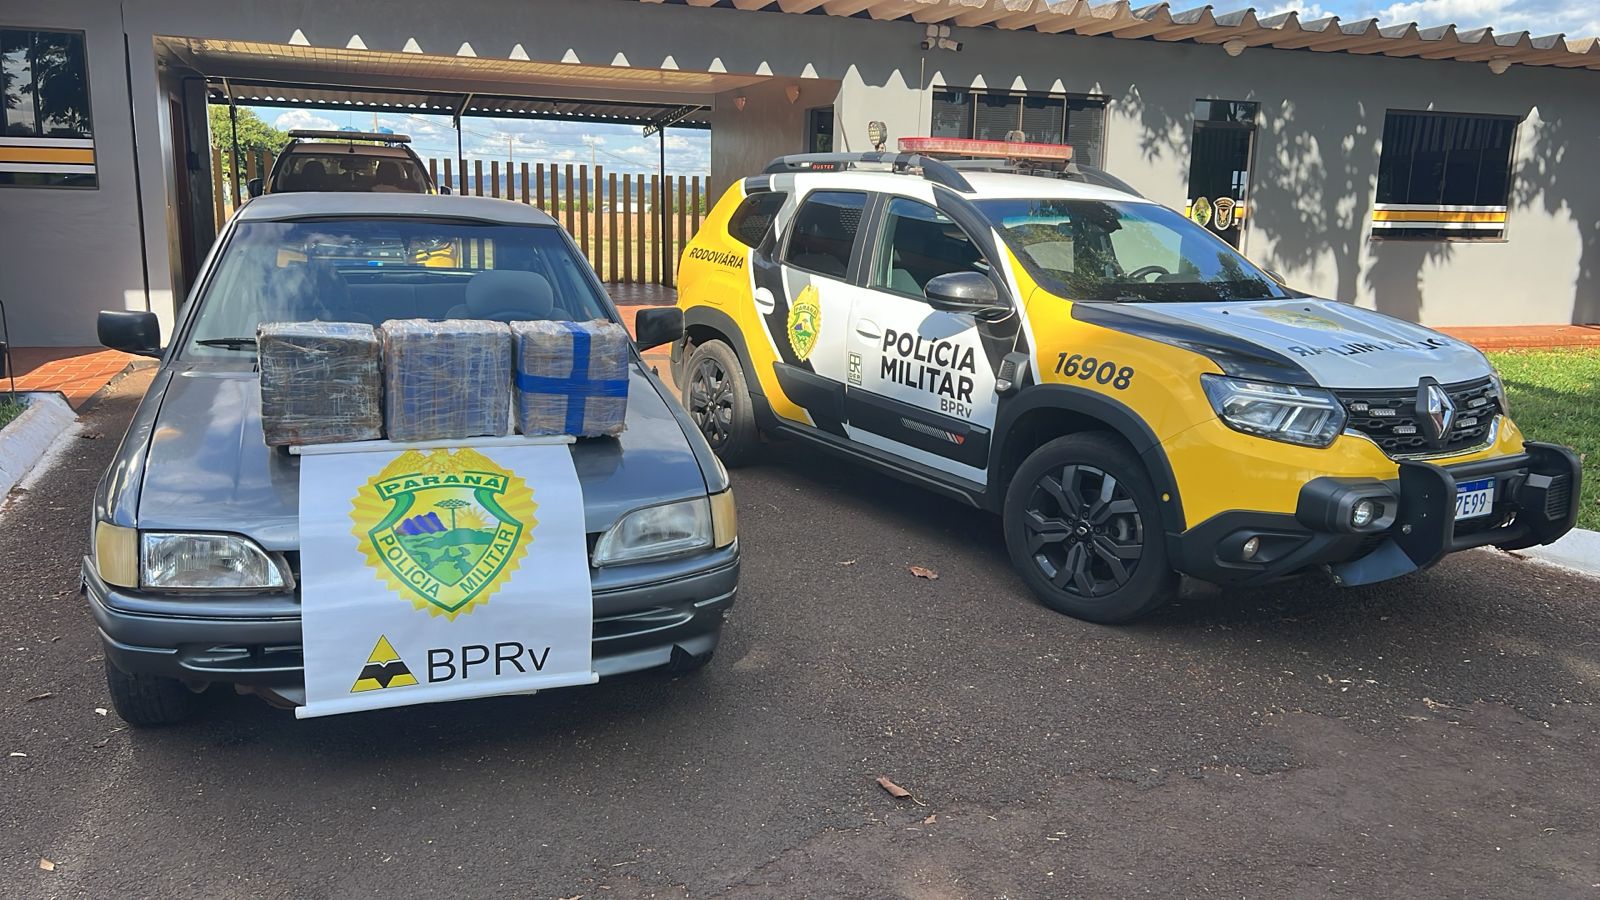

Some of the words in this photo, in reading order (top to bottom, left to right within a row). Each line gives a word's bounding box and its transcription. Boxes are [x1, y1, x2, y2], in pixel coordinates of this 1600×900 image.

[689, 248, 744, 269] RODOVIÁRIA
[883, 328, 976, 374] POLÍCIA
[1055, 352, 1134, 390] 16908
[881, 355, 974, 404] MILITAR
[383, 475, 500, 494] PARANÁ
[379, 534, 440, 597] POLÍCIA
[459, 529, 514, 594] MILITAR
[427, 641, 551, 683] BPRv
